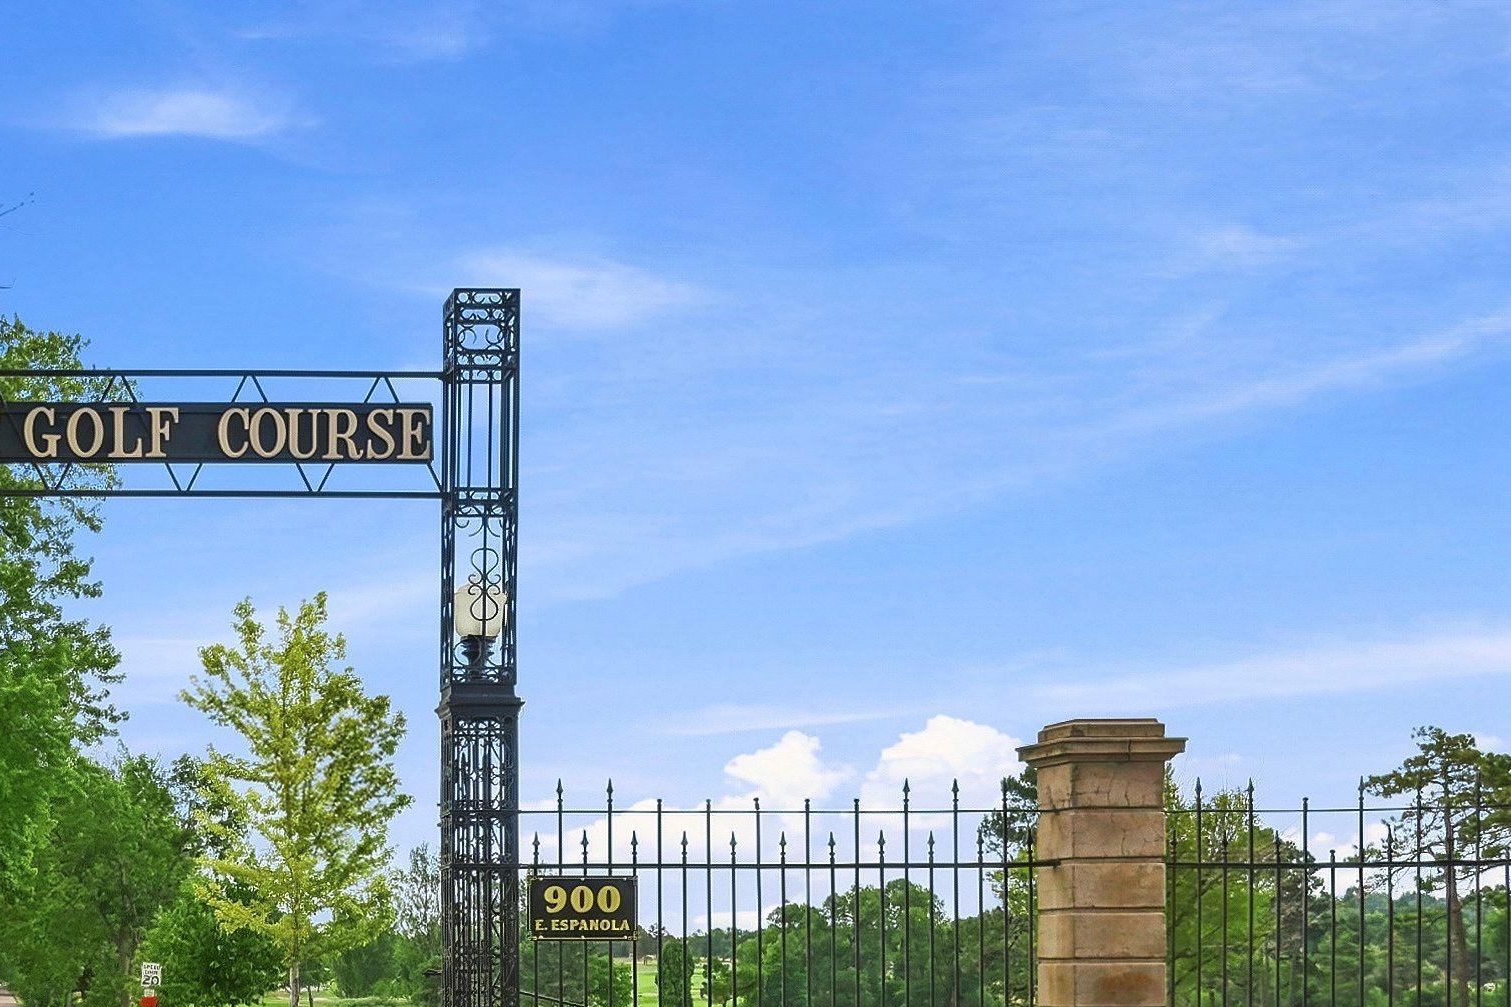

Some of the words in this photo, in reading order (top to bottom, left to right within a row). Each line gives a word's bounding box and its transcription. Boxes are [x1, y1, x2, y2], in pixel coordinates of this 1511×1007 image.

[23, 406, 179, 459] GOLF
[217, 407, 431, 460] COURSE
[544, 885, 621, 914] 900
[535, 919, 548, 931] E.
[551, 919, 630, 931] ESPANOLA
[142, 975, 159, 986] 20
